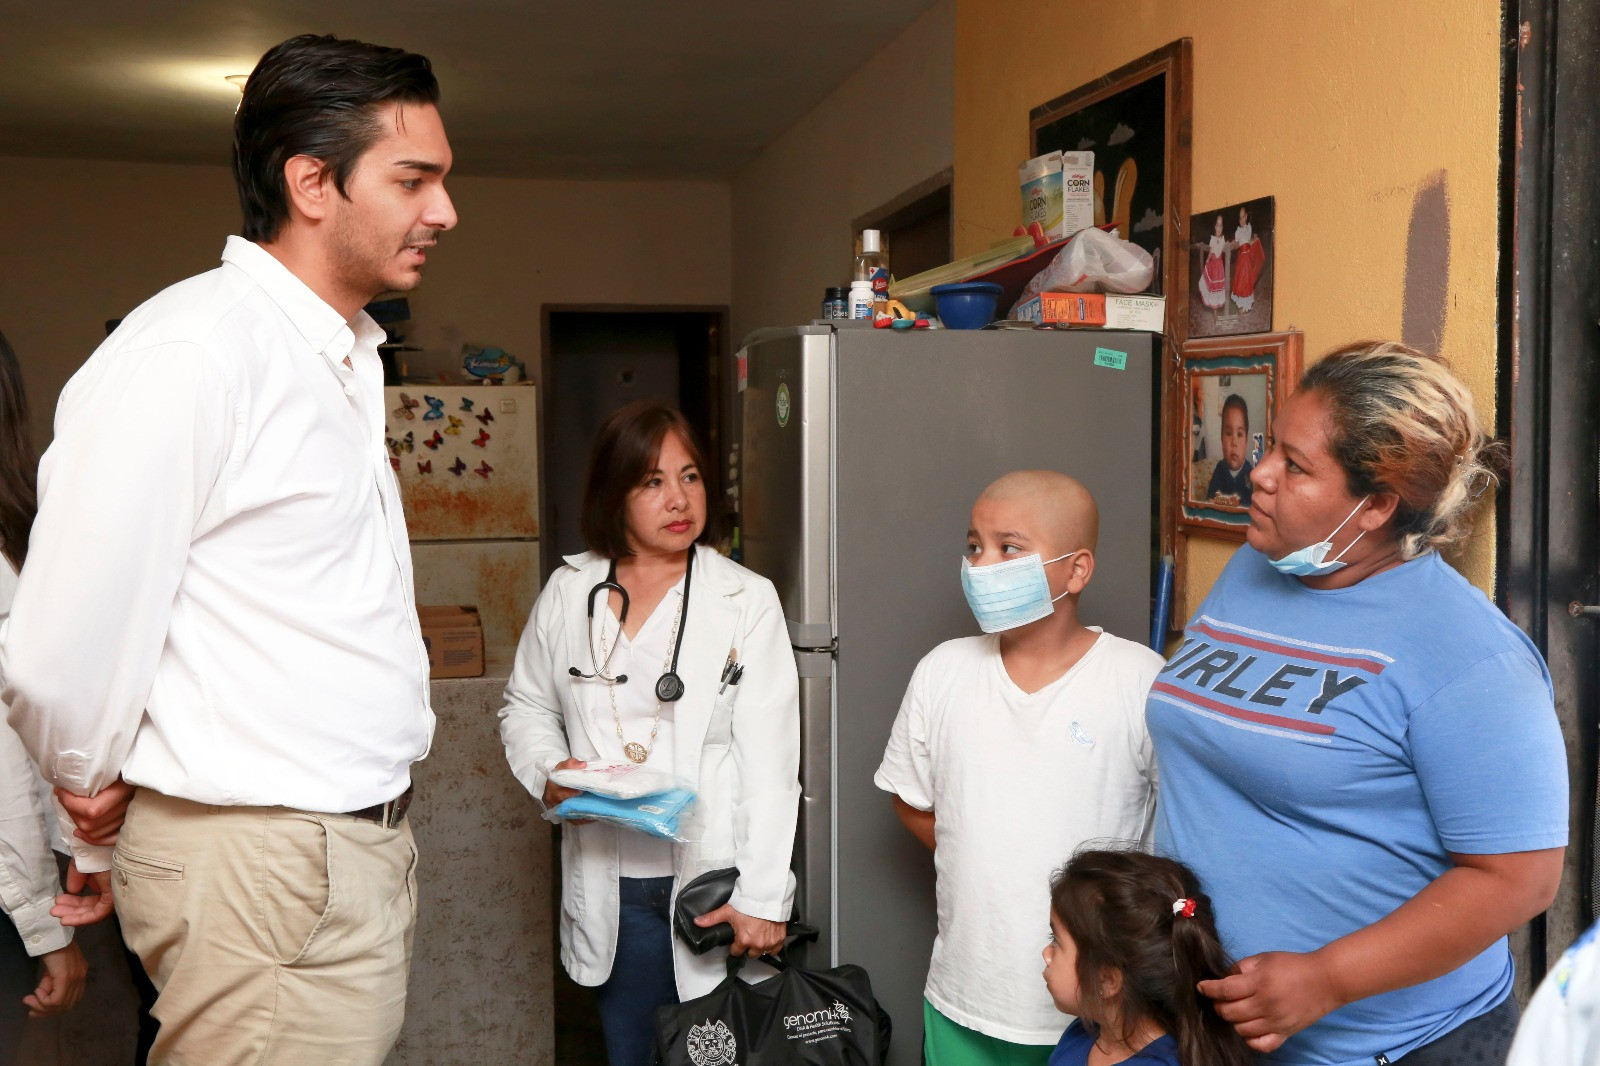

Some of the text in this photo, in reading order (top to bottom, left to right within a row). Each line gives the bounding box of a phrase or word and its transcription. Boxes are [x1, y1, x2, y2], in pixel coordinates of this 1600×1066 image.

[1067, 179, 1090, 187] CORN
[1029, 196, 1046, 211] CORN
[1115, 298, 1133, 306] FACE
[1135, 300, 1154, 308] MASK
